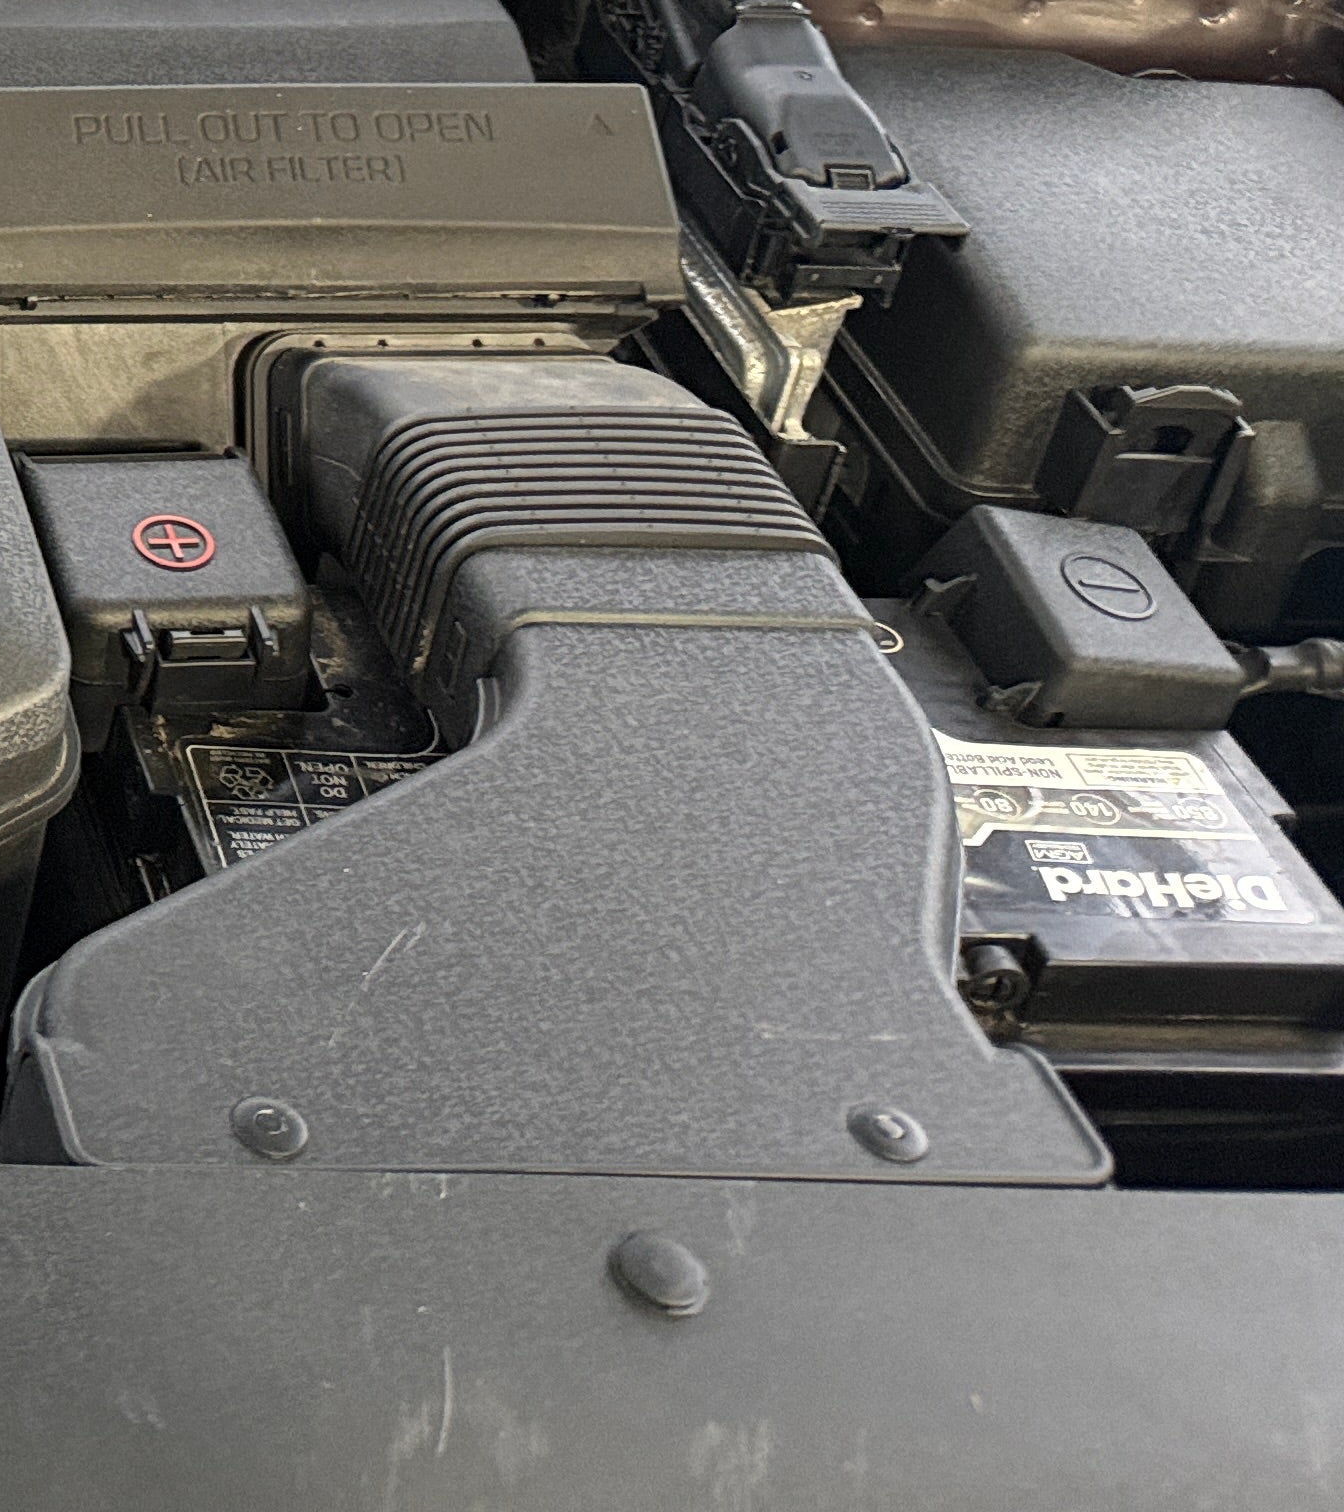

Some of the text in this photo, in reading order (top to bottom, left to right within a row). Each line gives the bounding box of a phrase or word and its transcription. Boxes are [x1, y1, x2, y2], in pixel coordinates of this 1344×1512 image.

[73, 109, 495, 145] PULL OUT TO OPEN
[986, 754, 1017, 765] Acid
[1018, 756, 1056, 767] Lead
[946, 764, 1064, 780] NON-SPILLABL
[312, 773, 348, 787] NOT
[319, 786, 349, 799] DO
[980, 796, 1013, 814] 80
[1068, 800, 1114, 819] 140
[276, 817, 301, 827] GET
[1033, 848, 1086, 862] AGM
[1038, 866, 1288, 911] DieHard
